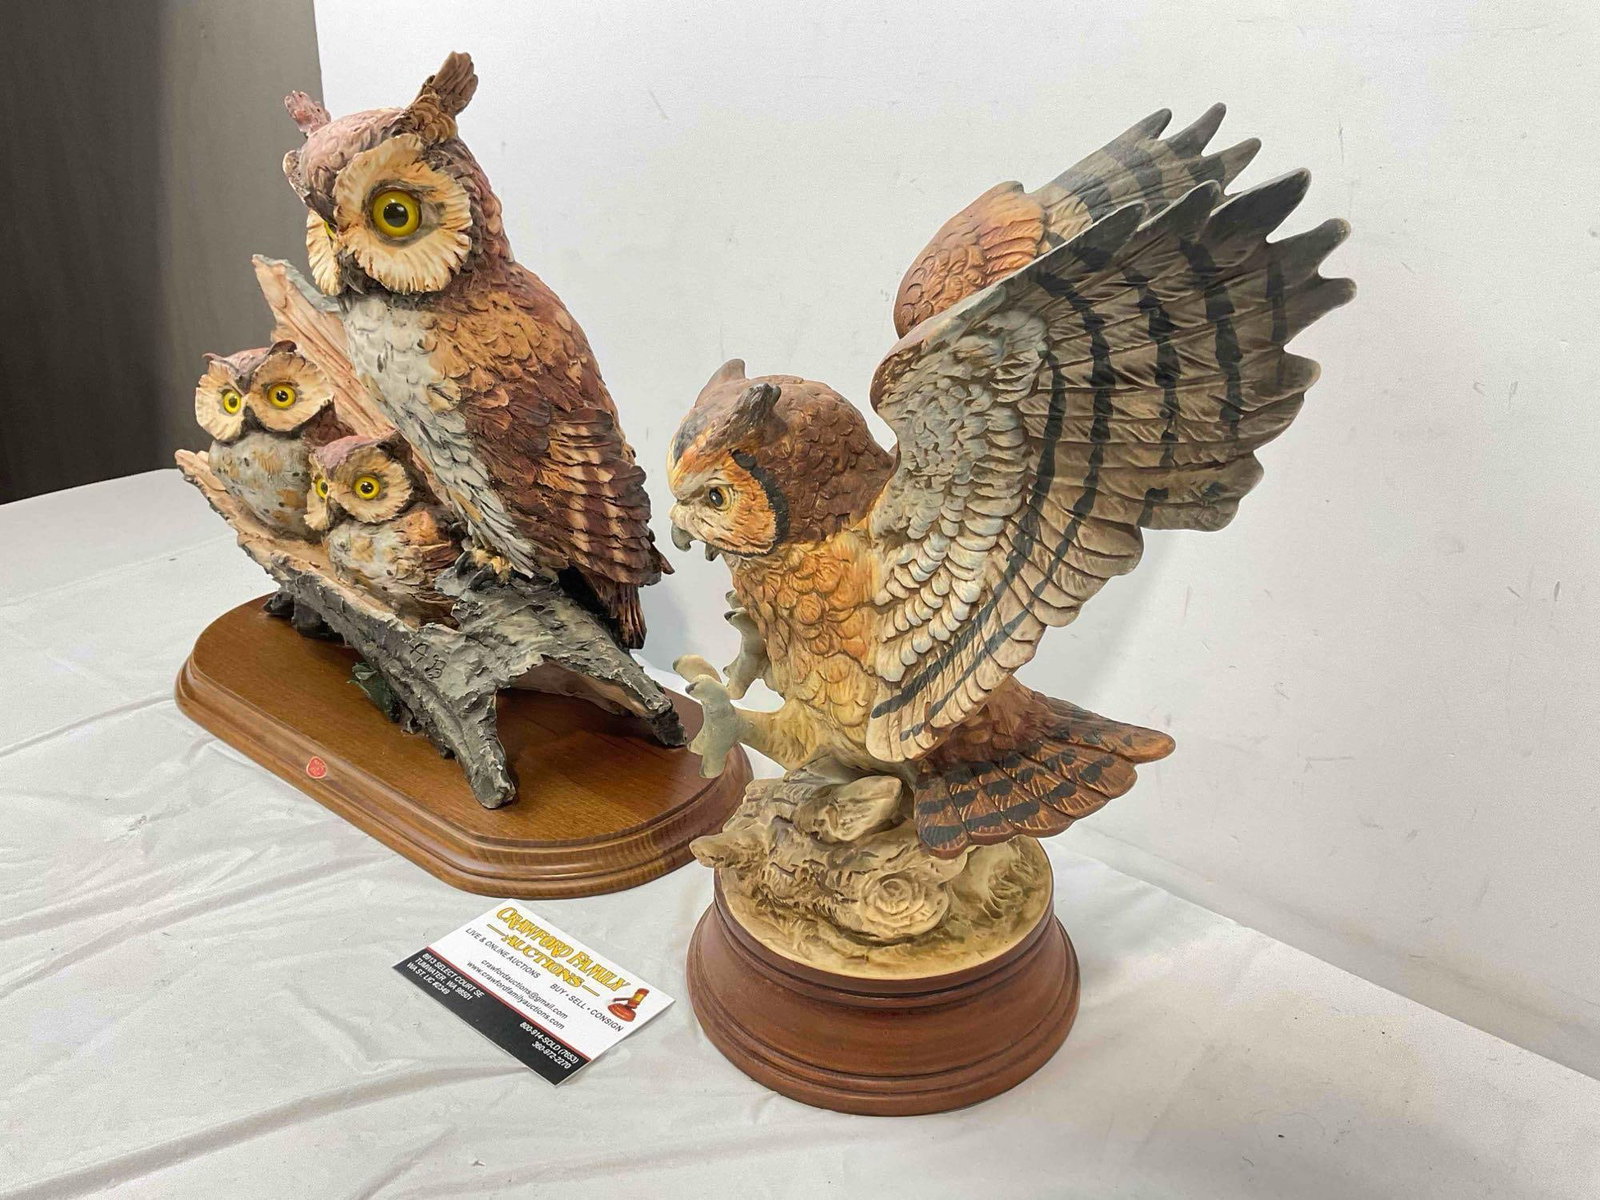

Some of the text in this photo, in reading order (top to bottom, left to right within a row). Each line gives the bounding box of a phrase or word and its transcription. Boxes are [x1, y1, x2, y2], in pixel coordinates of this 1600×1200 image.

[465, 927, 481, 939] LIVE
[484, 940, 510, 959] ONLINE
[507, 955, 541, 979] AUCTIONS
[496, 906, 631, 991] CRAWFORD FAMILY
[501, 934, 585, 988] AUCTIONS
[434, 961, 458, 978] SELECT
[455, 976, 477, 992] COURT
[473, 989, 485, 998] SE
[466, 961, 565, 1030] www.crawfordfamilyauctions.com
[481, 959, 568, 1020] crawfordauctions@gmail.com
[550, 983, 624, 1032] BUY SELL CONSIGN
